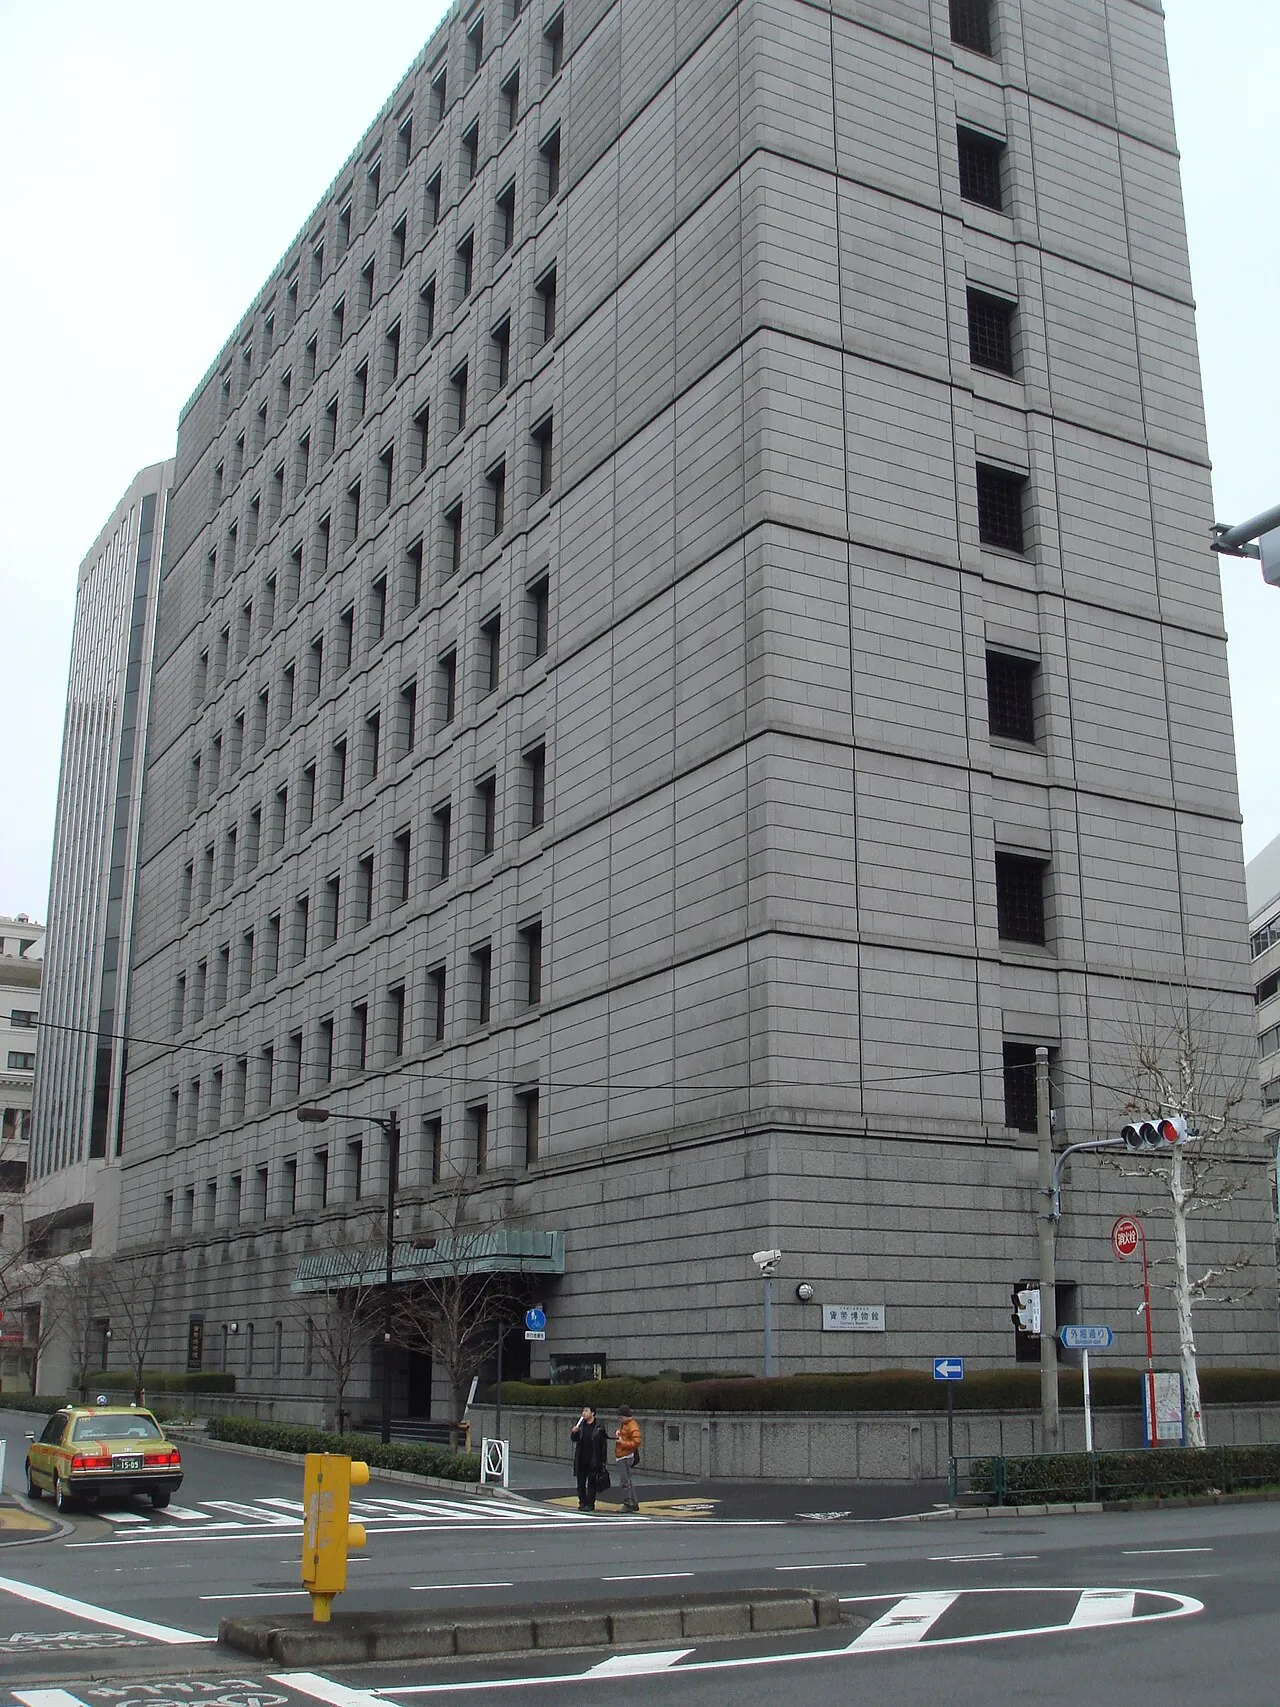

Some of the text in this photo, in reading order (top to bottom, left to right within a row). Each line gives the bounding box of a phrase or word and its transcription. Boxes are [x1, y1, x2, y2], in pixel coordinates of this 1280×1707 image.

[1117, 1230, 1136, 1246] 消火栓
[829, 1311, 879, 1321] 貨幣博物館
